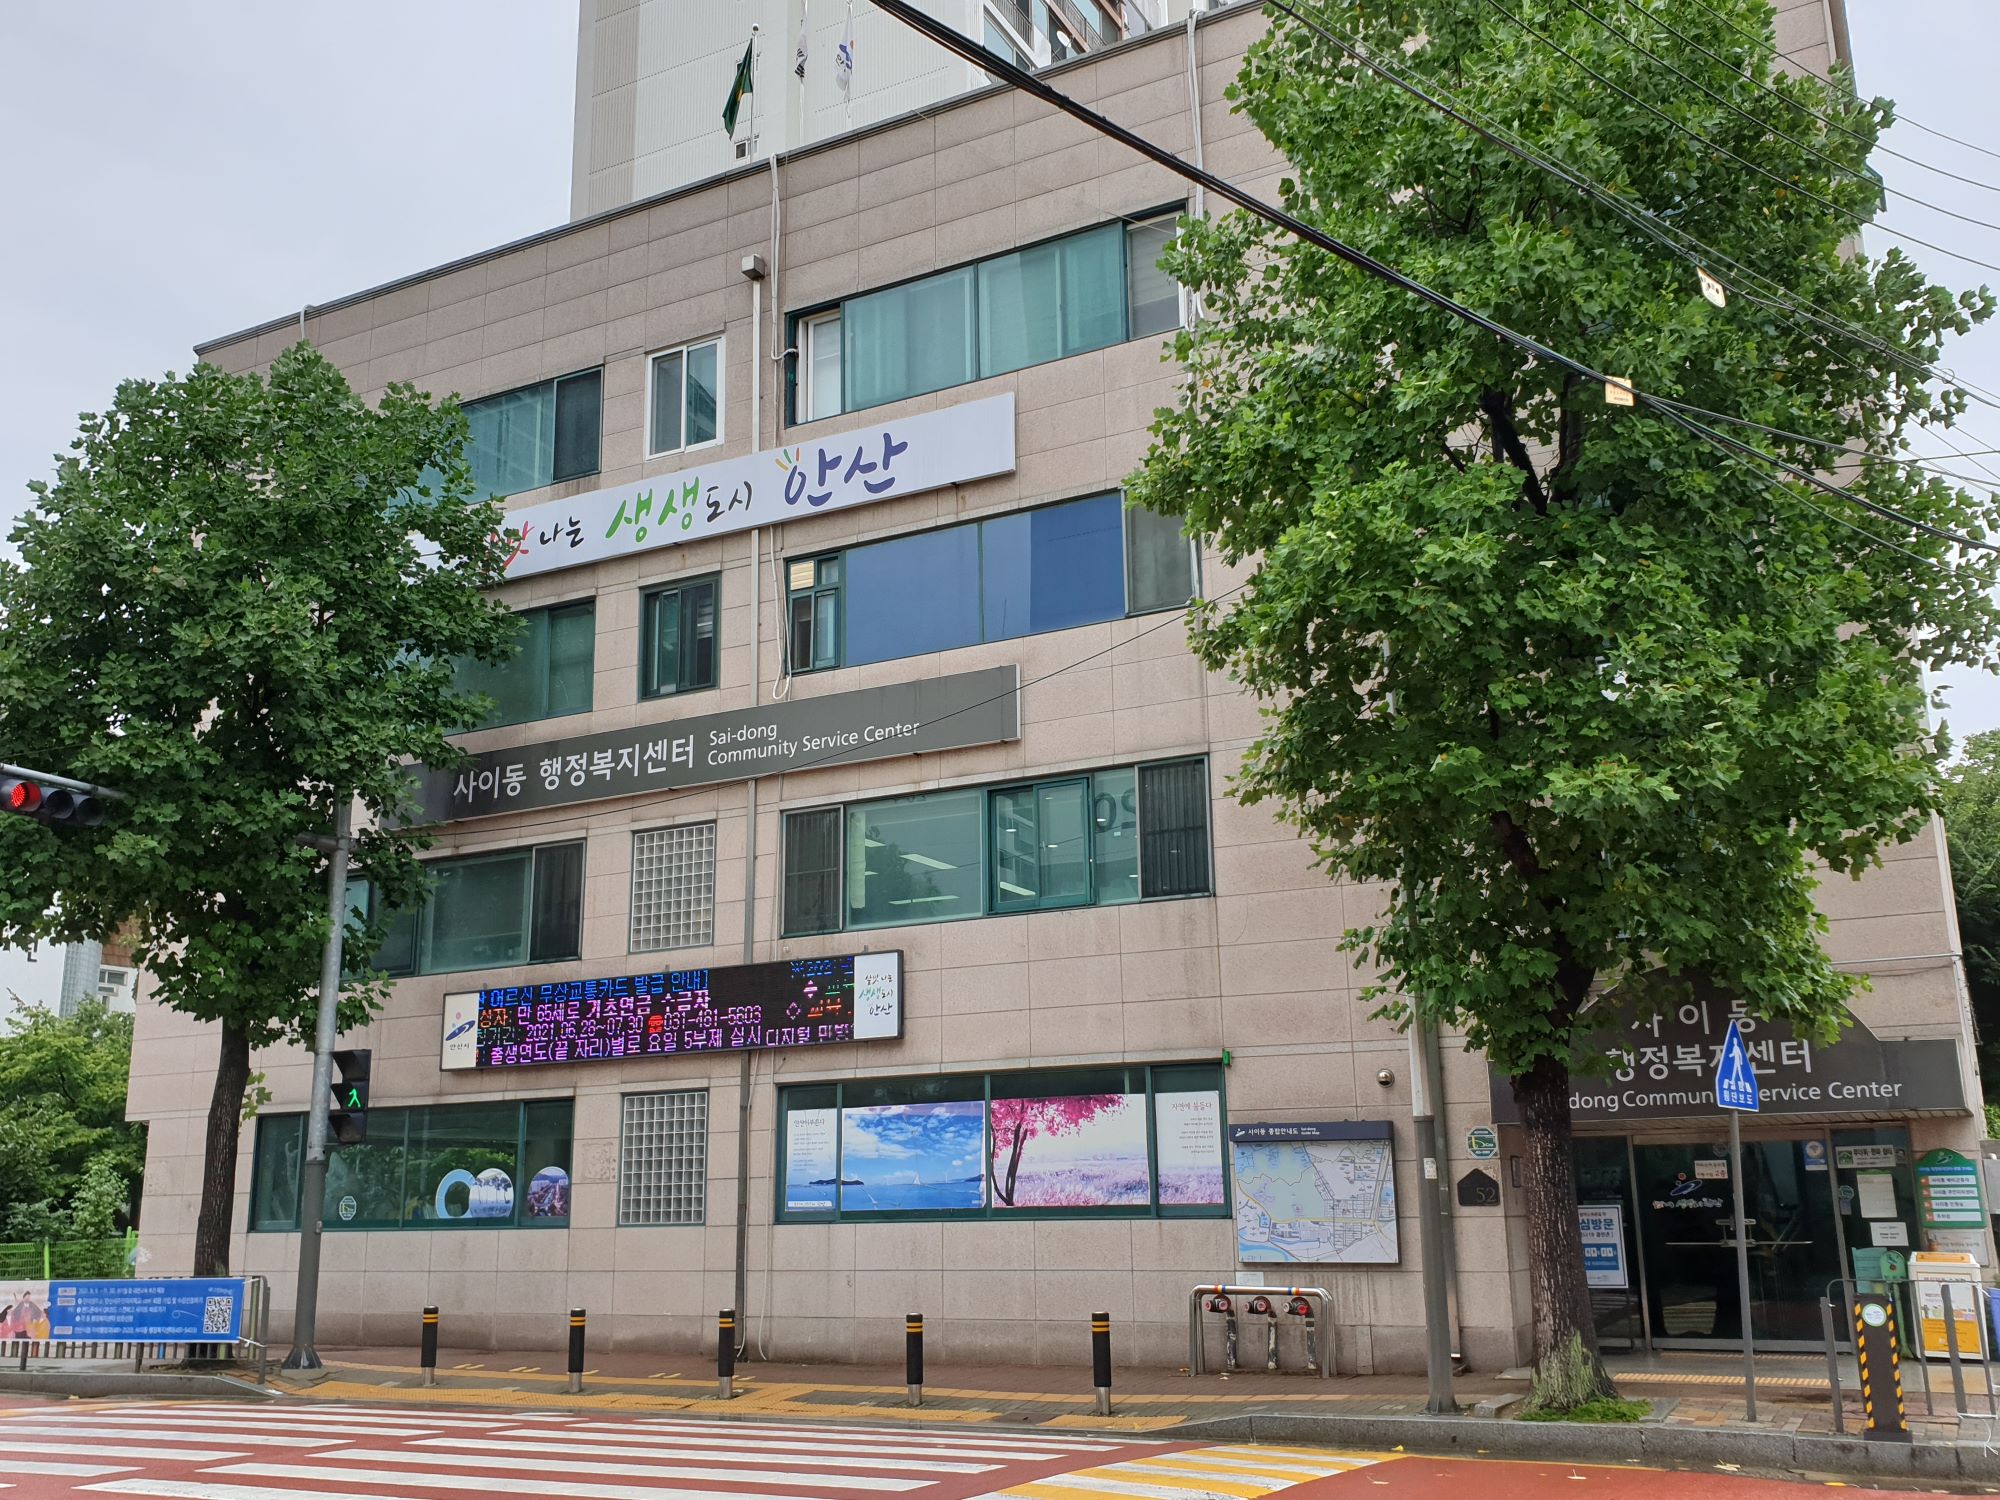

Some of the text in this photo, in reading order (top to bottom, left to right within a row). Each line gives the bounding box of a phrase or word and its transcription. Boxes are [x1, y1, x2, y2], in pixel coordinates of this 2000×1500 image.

[539, 515, 585, 548] 나는
[783, 431, 909, 507] 안산
[707, 720, 921, 767] Community Service Center
[708, 721, 778, 745] Sai-dong
[452, 732, 695, 804] 사이동 행정복지센터
[489, 985, 534, 1008] 어르신
[540, 978, 629, 1004] 무상교통카드
[634, 974, 665, 996] 발급
[671, 969, 709, 992] 안내]
[517, 1005, 533, 1026] 만
[585, 995, 652, 1020] 기초연금
[869, 1002, 893, 1016] 안산
[646, 1032, 678, 1053] 요일
[683, 1028, 723, 1051] 5부제
[730, 1025, 761, 1048] 실시
[1622, 1090, 1715, 1108] Commun
[1757, 1082, 1822, 1102] ervice
[1827, 1080, 1903, 1100] Center
[1579, 1218, 1615, 1231] 심방문
